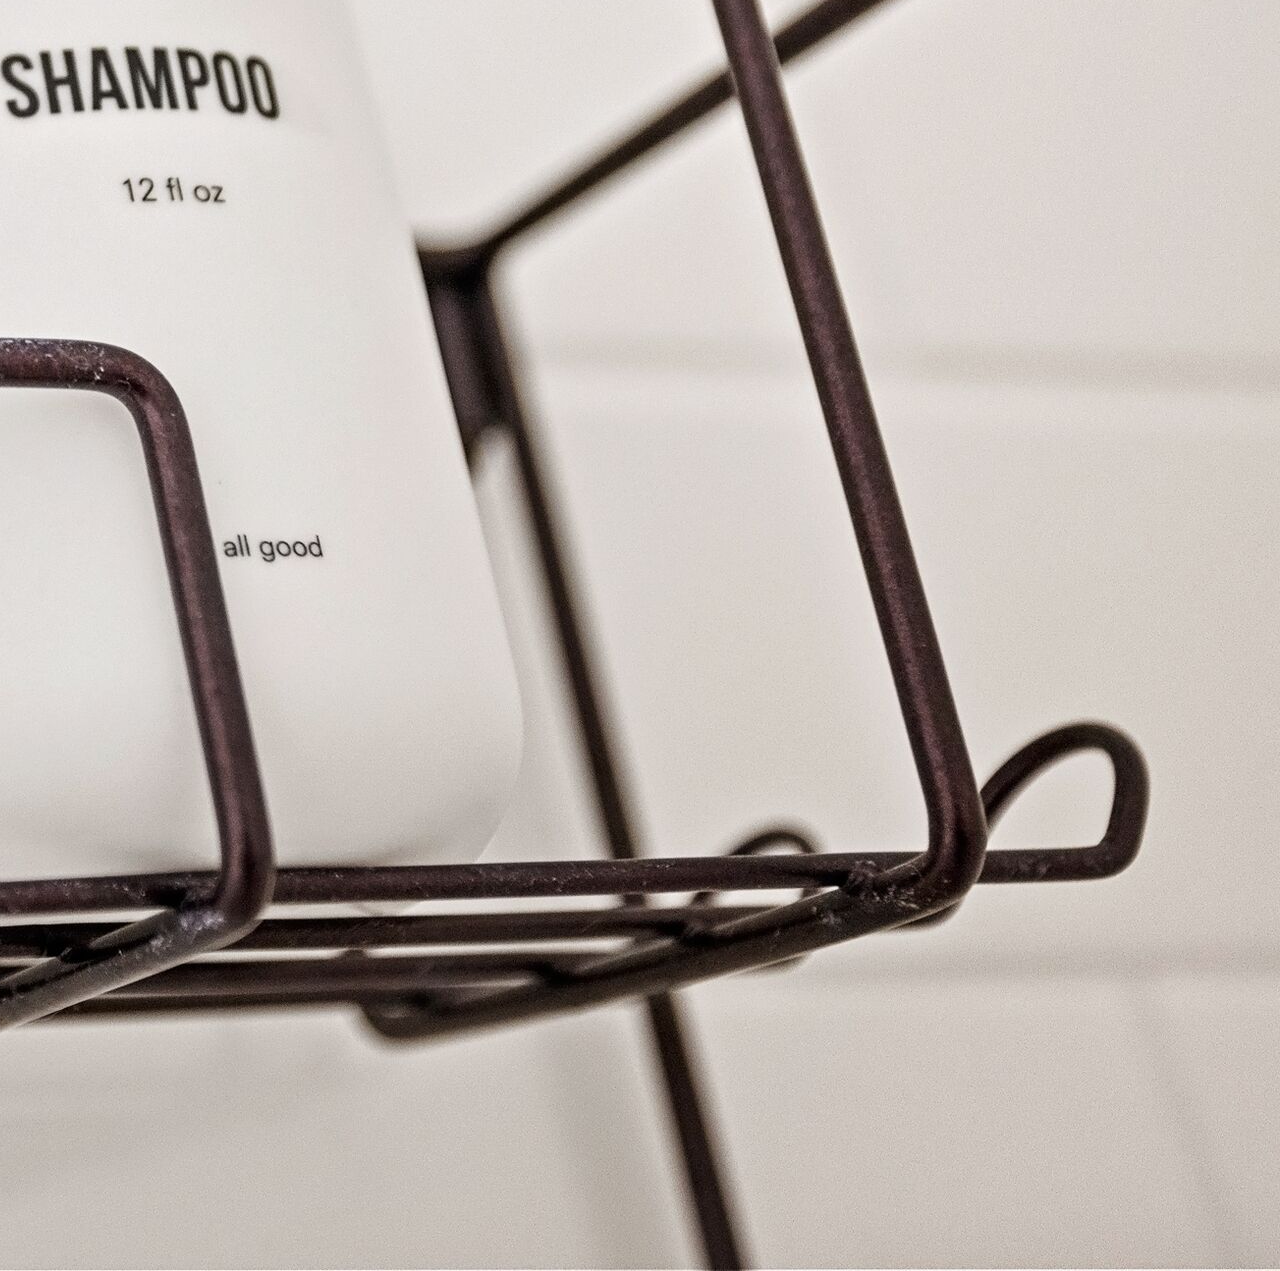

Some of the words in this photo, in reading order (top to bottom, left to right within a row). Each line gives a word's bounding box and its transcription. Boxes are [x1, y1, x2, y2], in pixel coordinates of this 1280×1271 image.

[0, 45, 281, 121] SHAMPOO
[121, 176, 159, 204] 12
[165, 176, 185, 203] fl
[192, 183, 227, 204] oz
[222, 533, 252, 558] all
[258, 534, 324, 563] good
